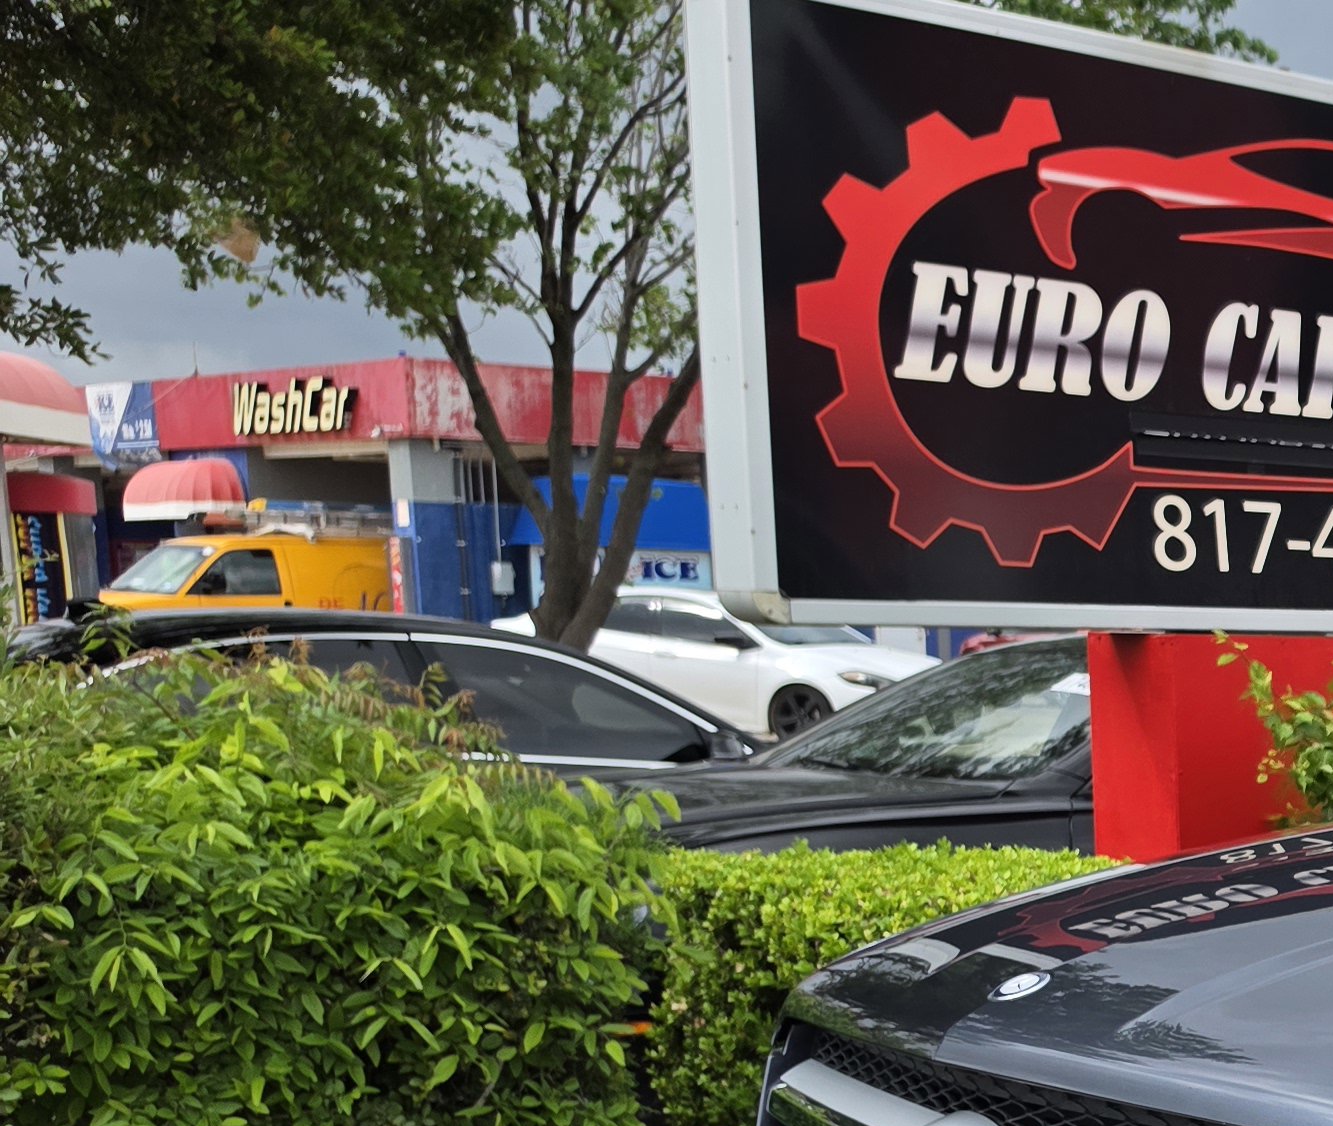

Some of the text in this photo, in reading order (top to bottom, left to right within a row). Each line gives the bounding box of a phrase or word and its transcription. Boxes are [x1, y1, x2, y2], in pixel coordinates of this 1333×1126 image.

[894, 262, 1172, 402] EURO
[233, 375, 349, 437] WashCar
[641, 557, 700, 580] ICE
